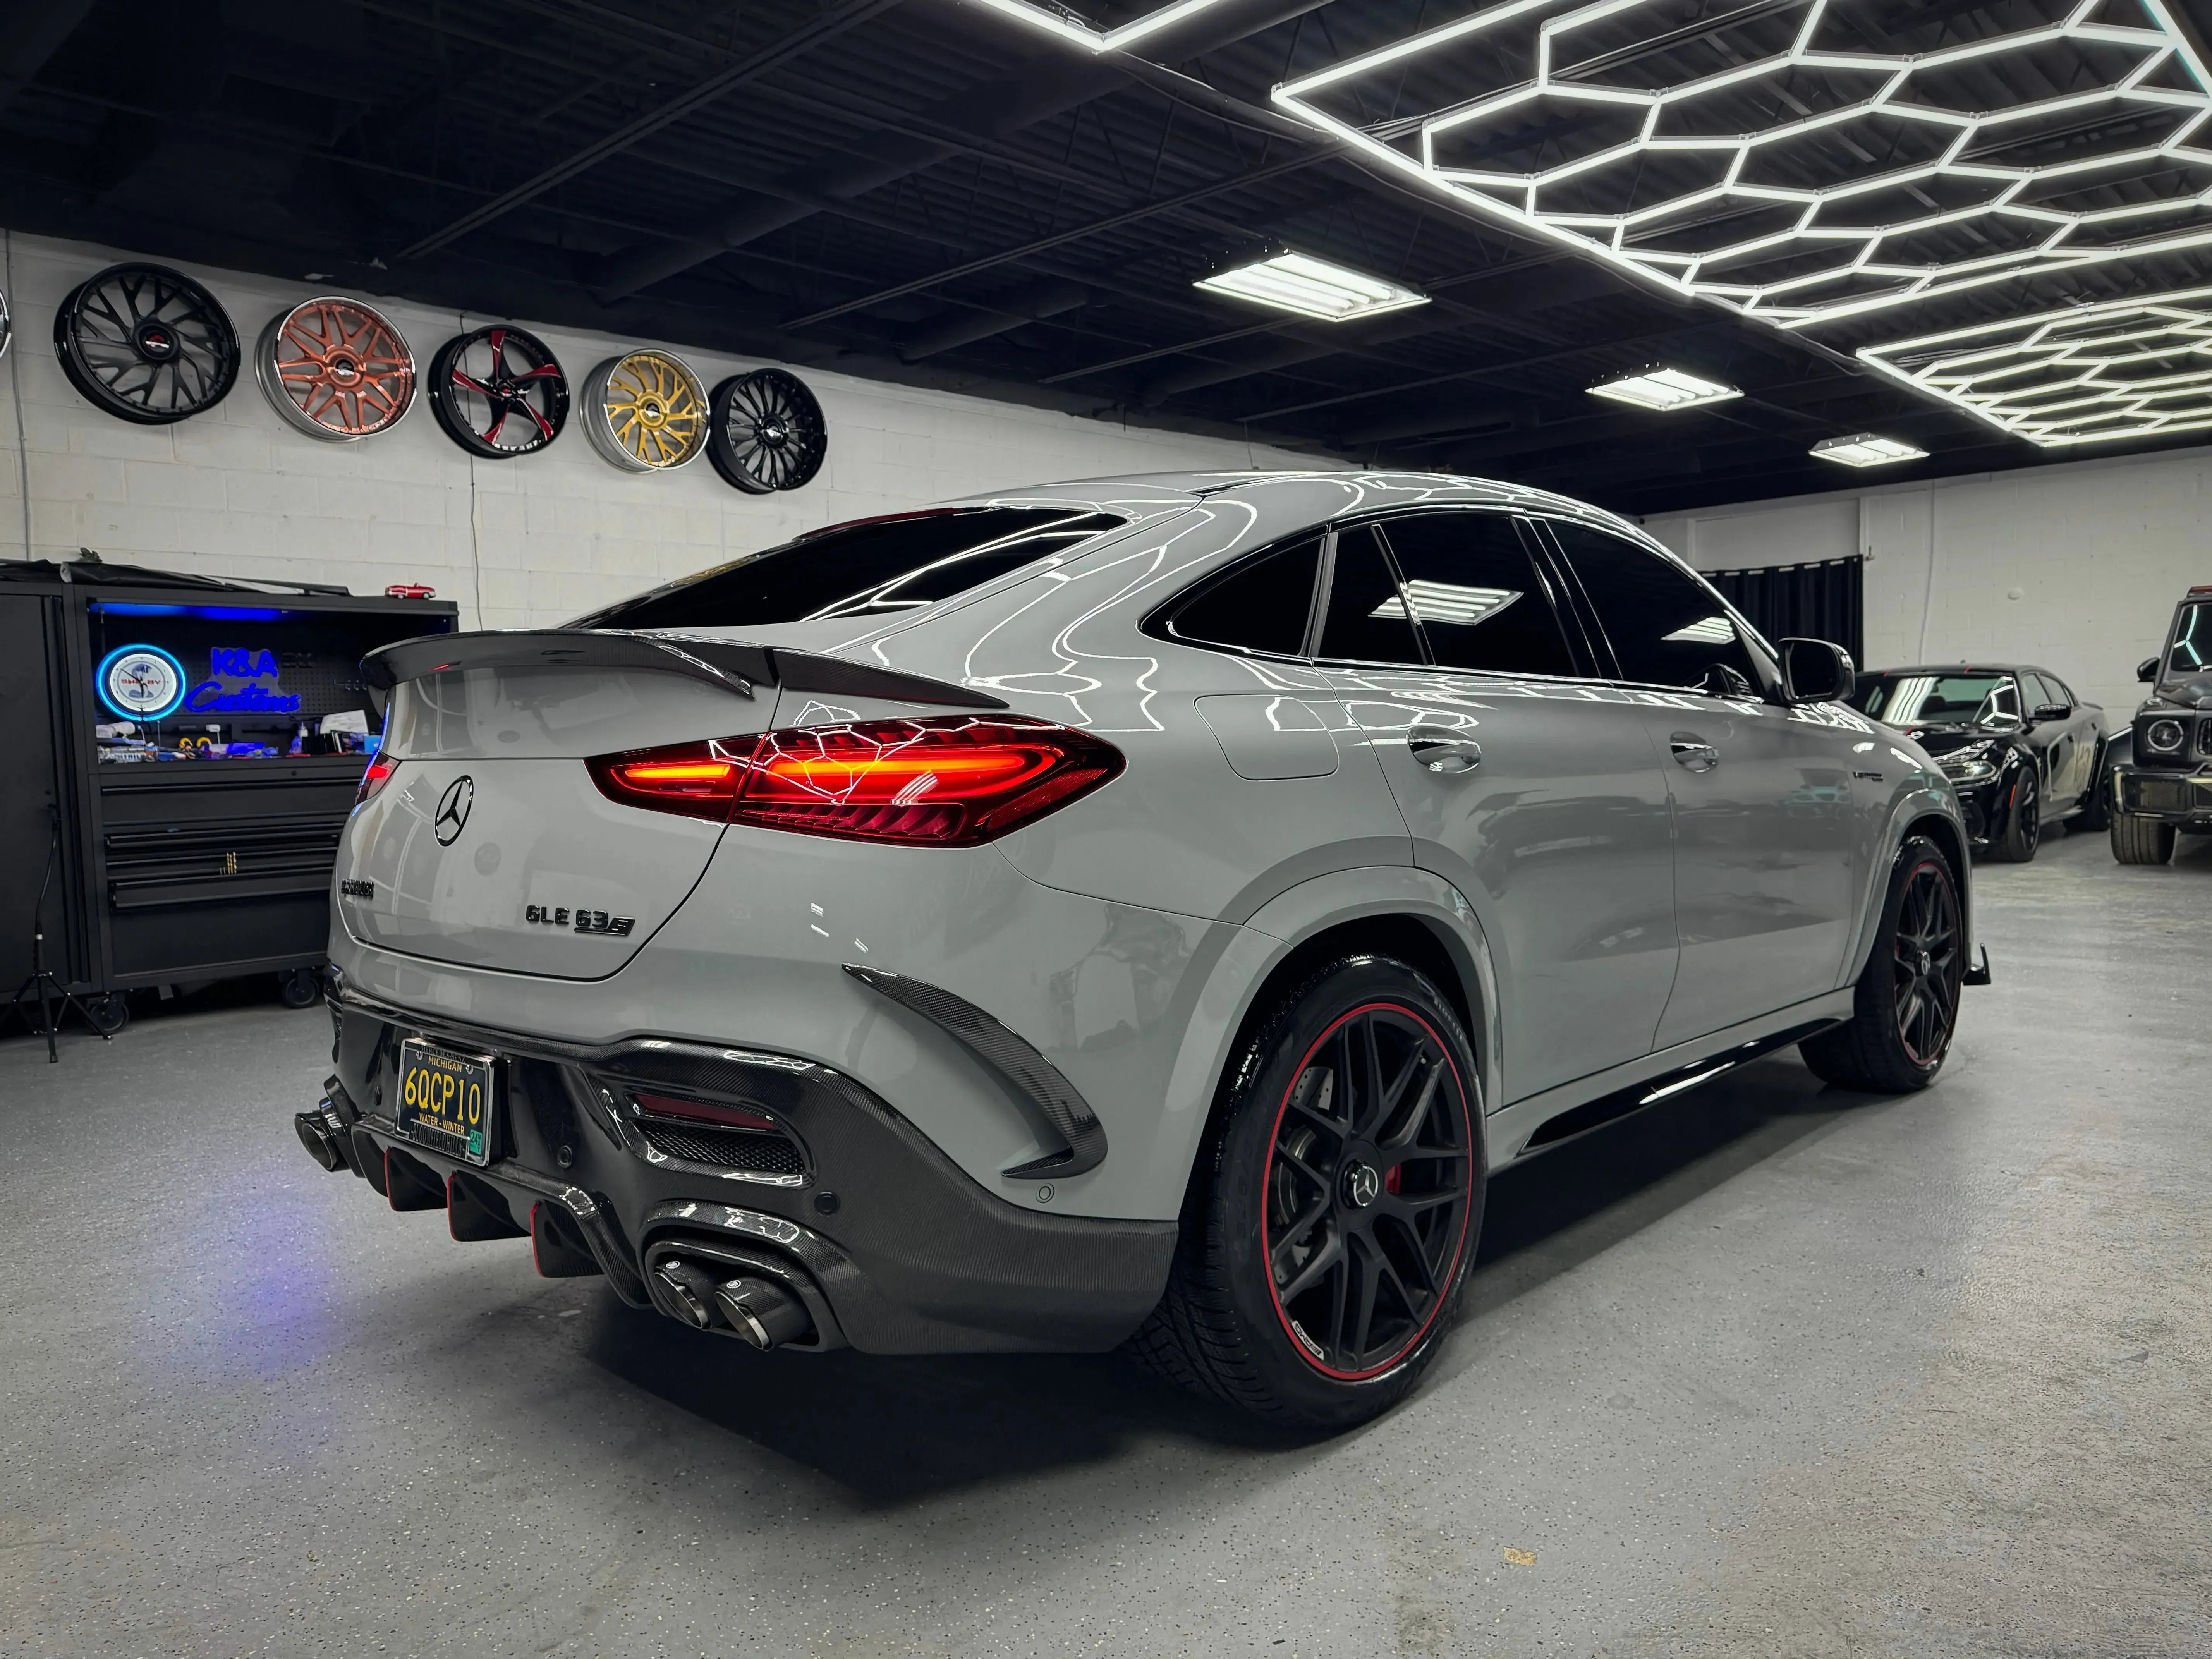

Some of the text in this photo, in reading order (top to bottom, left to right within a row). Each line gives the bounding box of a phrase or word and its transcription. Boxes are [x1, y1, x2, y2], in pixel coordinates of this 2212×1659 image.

[213, 647, 278, 678] K&A
[185, 681, 302, 713] Customs
[526, 905, 570, 924] GLE
[428, 1056, 462, 1072] MICHIGAN
[405, 1067, 481, 1125] 6QCP10
[419, 1112, 438, 1127] WATER
[443, 1119, 464, 1135] WINTER
[471, 1131, 477, 1145] 24
